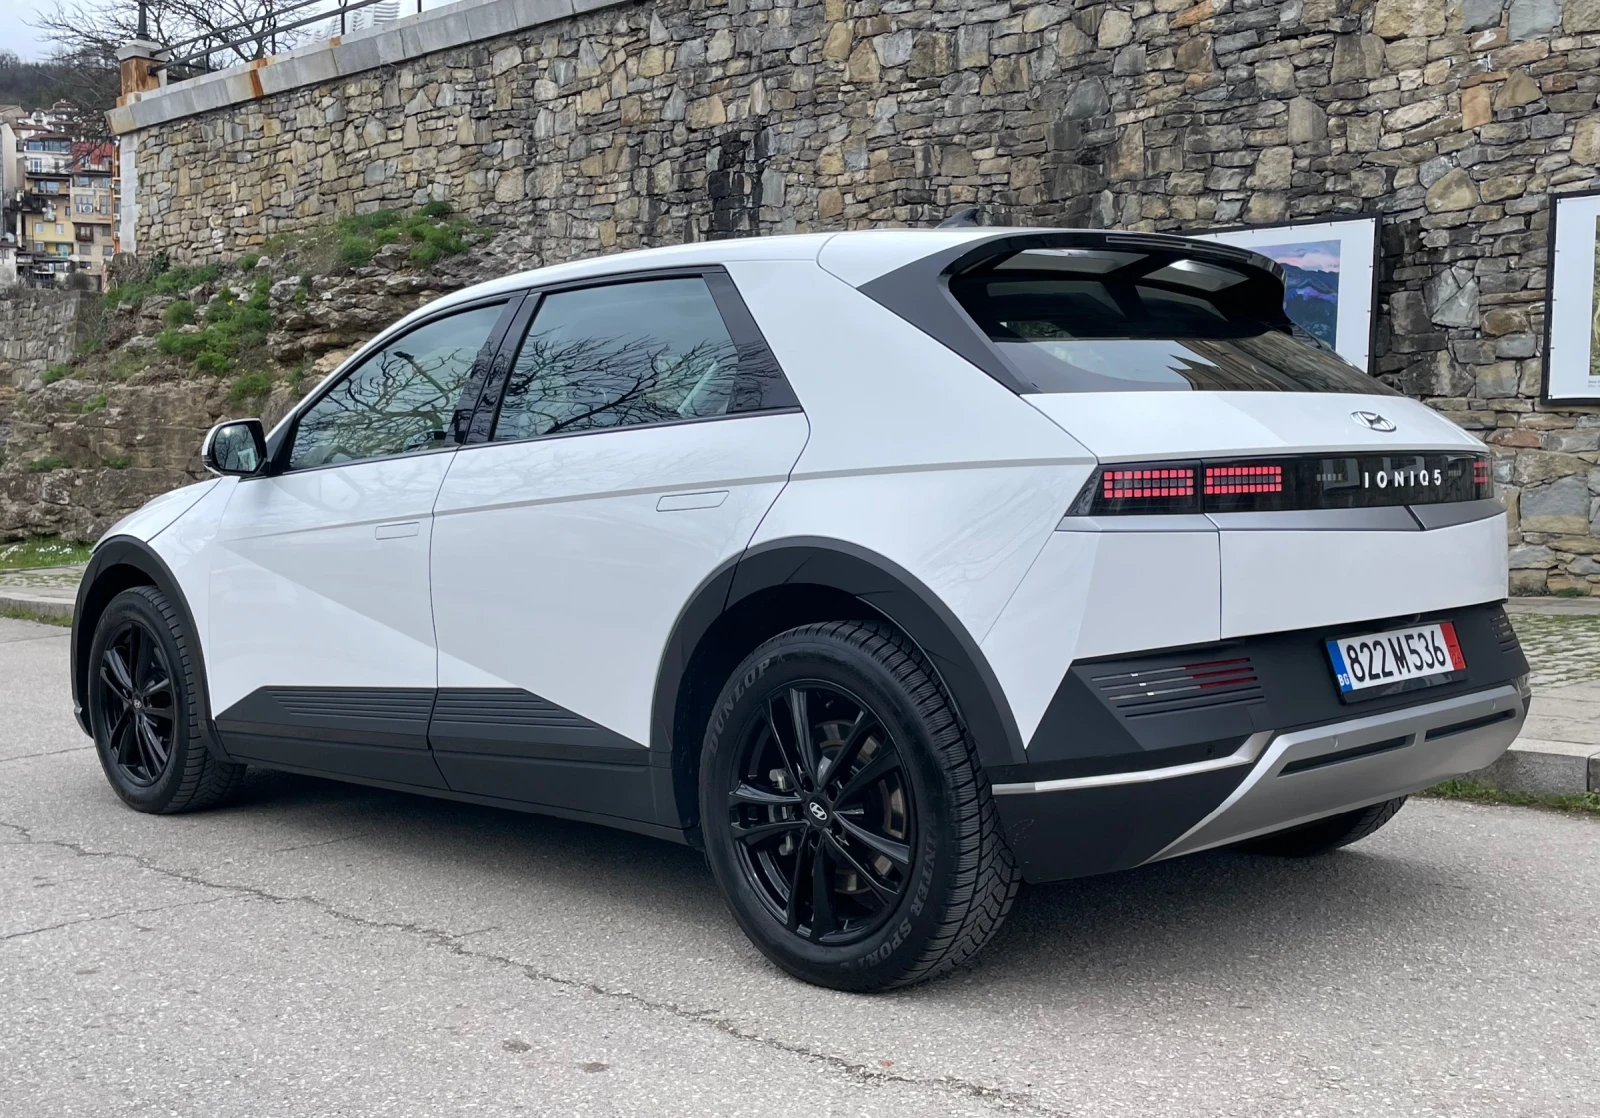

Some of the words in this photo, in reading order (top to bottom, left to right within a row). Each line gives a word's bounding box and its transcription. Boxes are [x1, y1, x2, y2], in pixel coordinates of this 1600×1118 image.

[1337, 673, 1350, 686] BG
[1346, 630, 1446, 682] 822M536
[709, 658, 770, 757] DUNLOP
